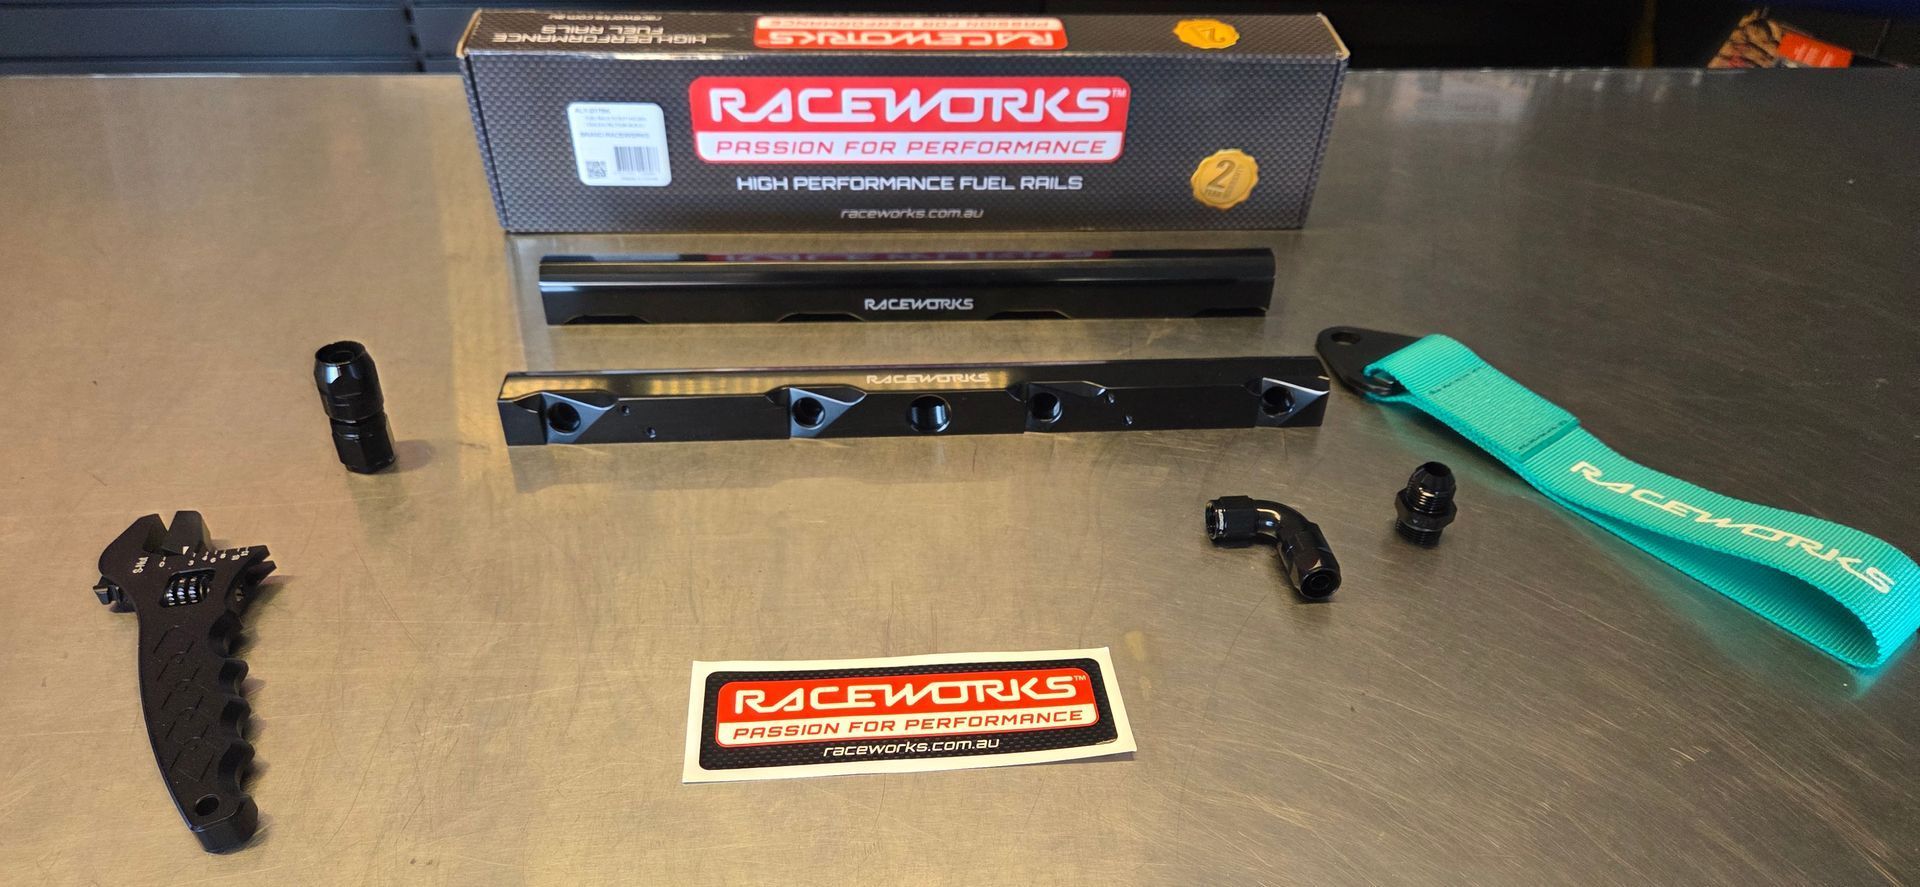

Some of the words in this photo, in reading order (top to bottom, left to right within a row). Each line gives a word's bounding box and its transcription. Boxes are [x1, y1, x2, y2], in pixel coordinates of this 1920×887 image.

[540, 24, 604, 34] RAILS
[611, 26, 664, 35] FUEL
[770, 19, 908, 29] PERFORMANCE
[918, 19, 960, 29] FOR
[975, 20, 1050, 29] PASSION
[491, 33, 660, 43] PERFORMANCE
[661, 34, 707, 45] HIGH
[768, 30, 1054, 46] RACEWORKS
[708, 87, 1111, 123] RACEWORKS
[716, 140, 834, 155] PASSION
[845, 140, 898, 155] FOR
[906, 139, 1107, 155] PERFORMANCE
[1207, 159, 1236, 192] 2
[736, 175, 790, 191] HIGH
[793, 176, 956, 191] PERFORMANCE
[959, 176, 1016, 191] FUEL
[1020, 176, 1084, 191] RAILS
[840, 207, 985, 220] raceworks.com.au
[864, 298, 974, 310] RACEWORKS
[866, 373, 990, 384] RACEWORKS
[1570, 461, 1898, 594] RACEWORKS
[735, 675, 1073, 715] RACEWORKS
[733, 724, 840, 740] PASSION
[848, 719, 896, 734] FOR
[905, 710, 1084, 730] PERFORMANCE
[822, 738, 1001, 758] raceworks.com.au
